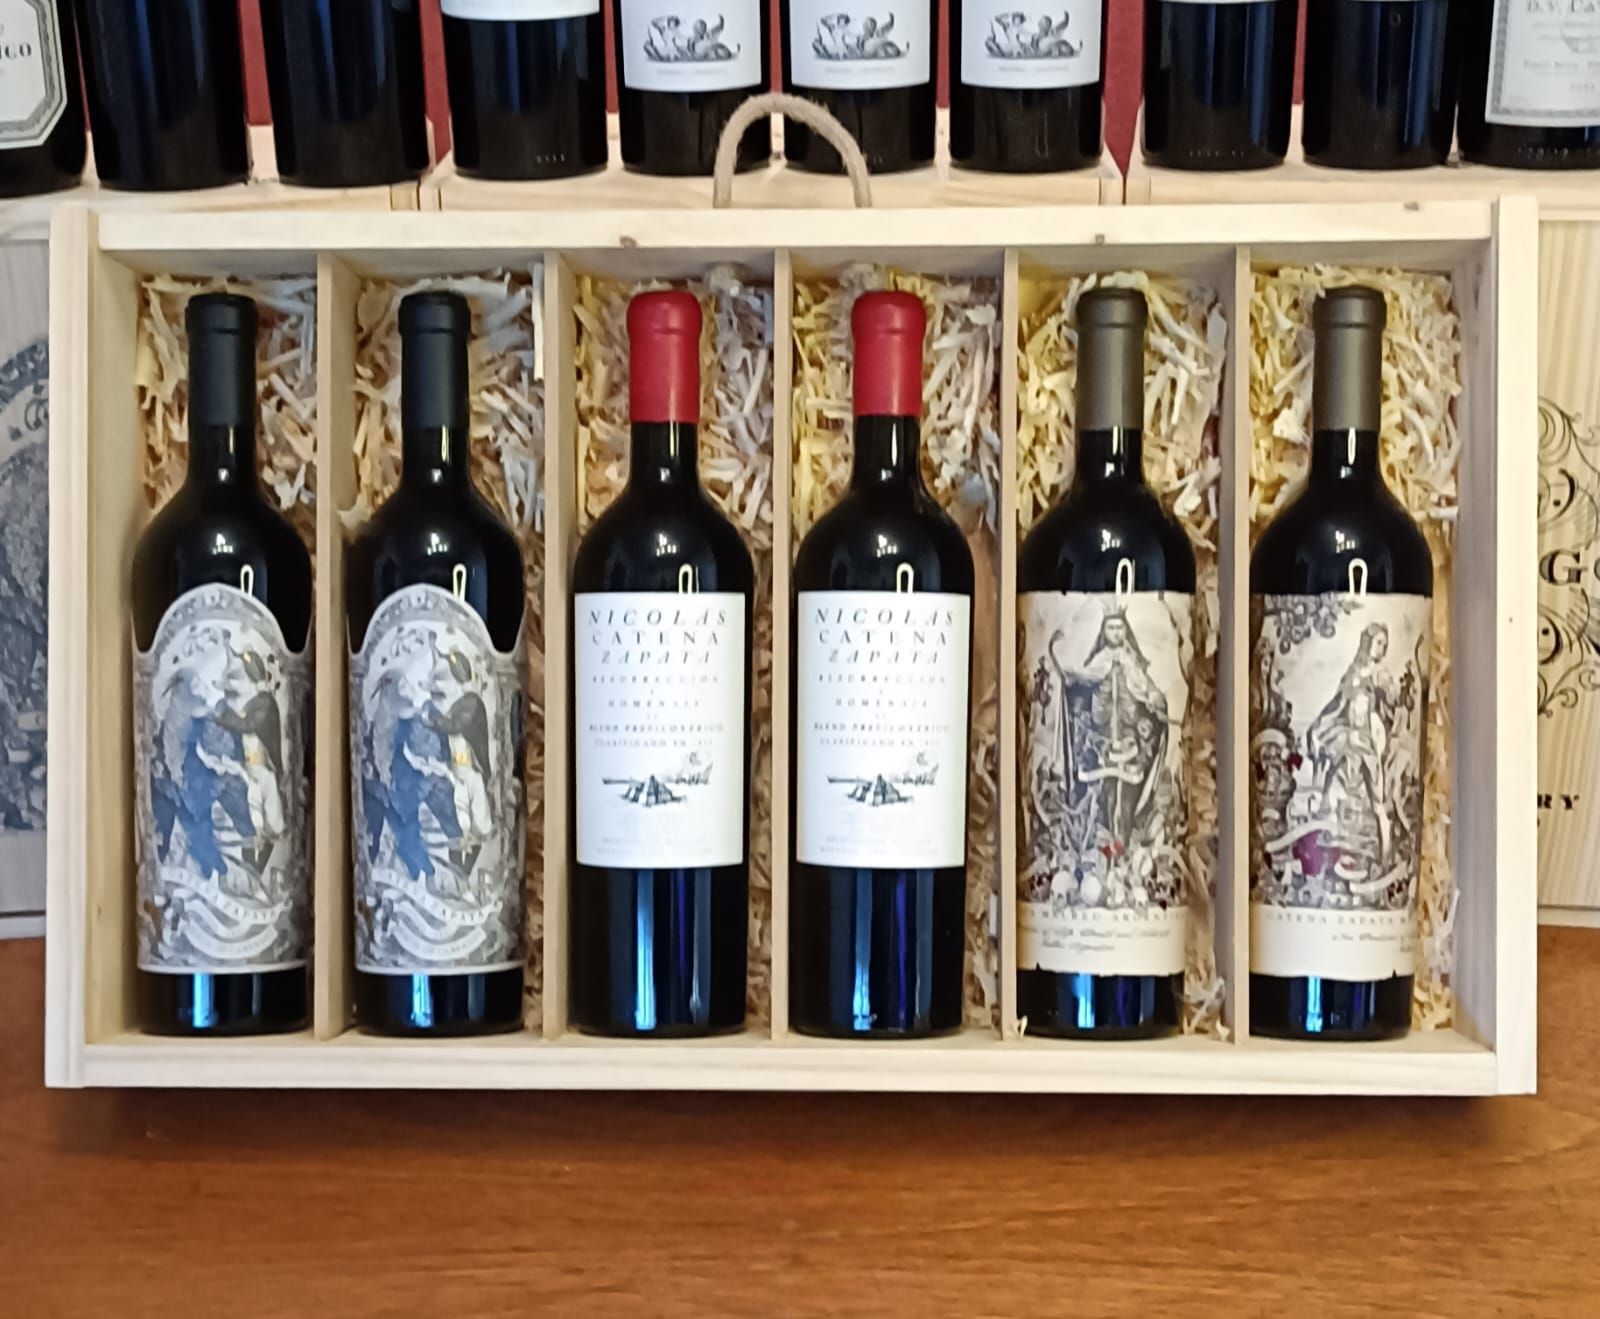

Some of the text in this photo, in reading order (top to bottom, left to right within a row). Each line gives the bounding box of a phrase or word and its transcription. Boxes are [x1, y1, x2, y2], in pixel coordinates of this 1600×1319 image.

[1538, 549, 1600, 586] G
[592, 631, 718, 645] CATENA
[818, 630, 947, 645] CATENA
[601, 651, 711, 664] ZAPATA
[828, 650, 938, 664] ZAPATA
